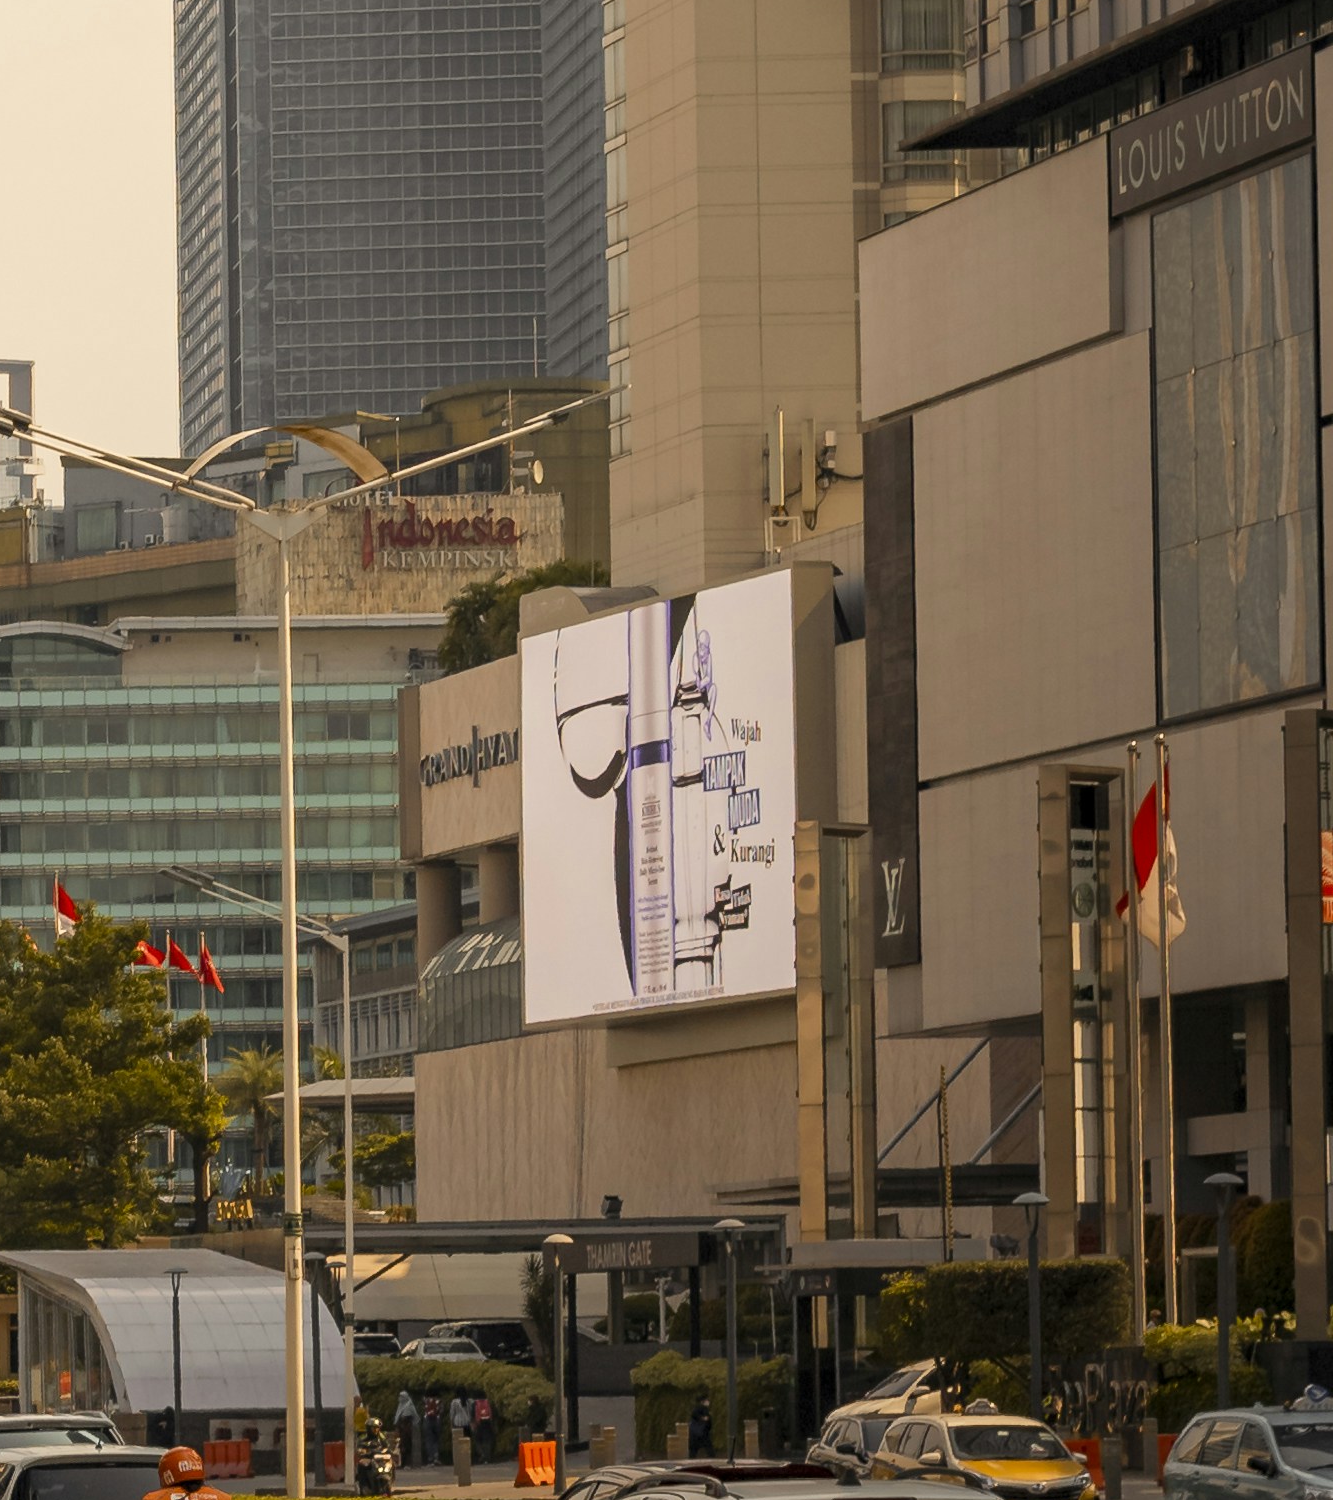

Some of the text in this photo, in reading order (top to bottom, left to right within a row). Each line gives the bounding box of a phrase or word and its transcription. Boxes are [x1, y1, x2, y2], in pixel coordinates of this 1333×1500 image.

[1118, 68, 1305, 195] LOUIS VUITTON
[361, 498, 528, 572] Indonesia
[731, 718, 762, 747] Wajah
[419, 743, 473, 788] GRAND
[704, 752, 745, 791] TAMPAK
[729, 790, 760, 828] MUDA
[713, 823, 775, 869] & Kurangi
[628, 1239, 652, 1266] GATE
